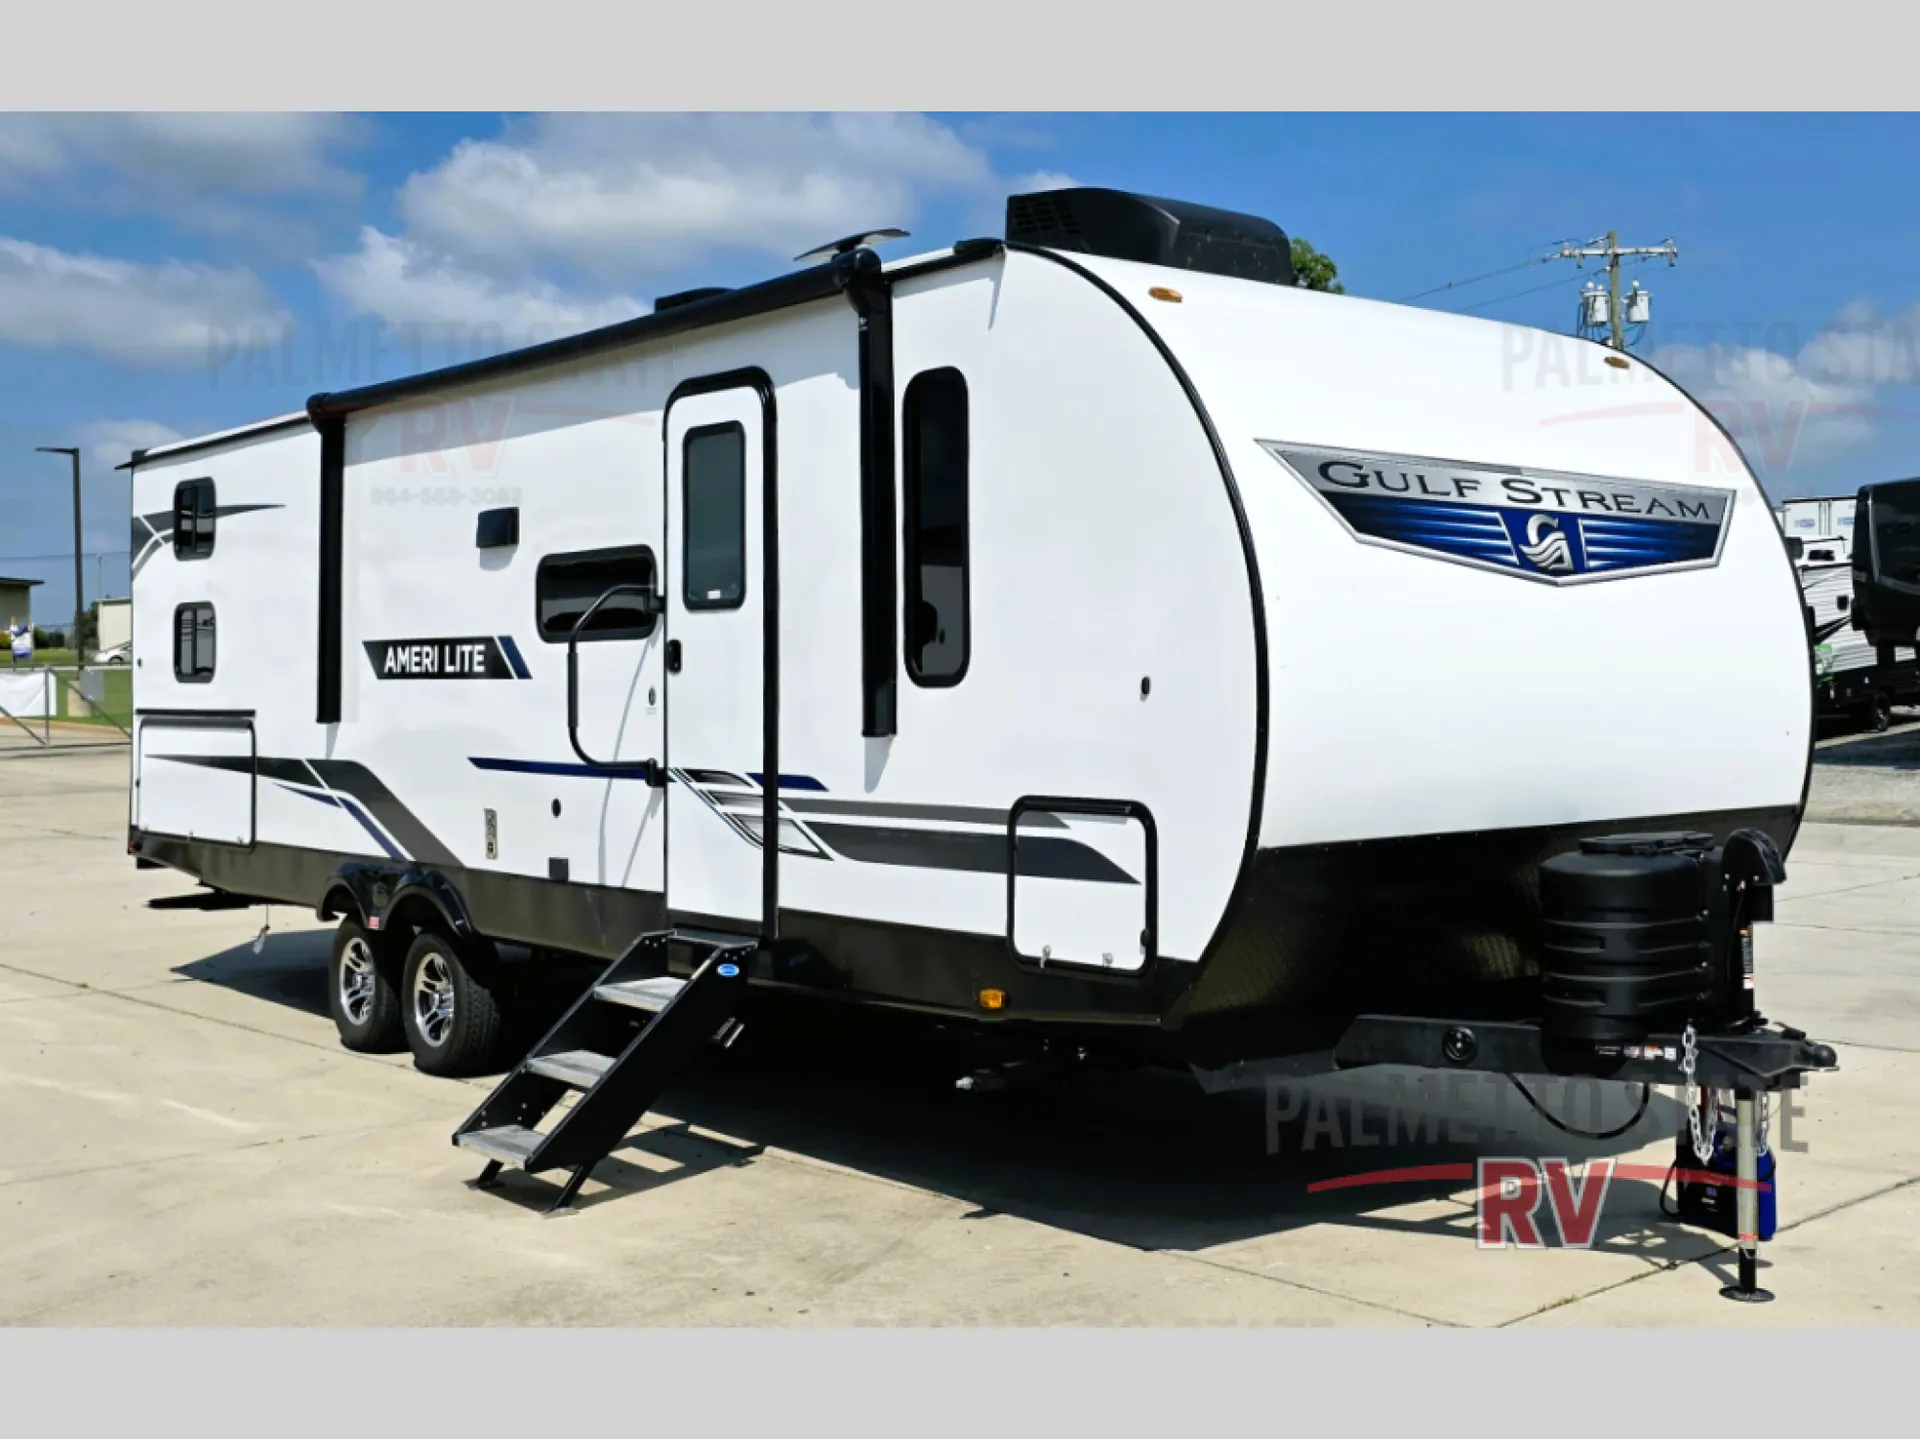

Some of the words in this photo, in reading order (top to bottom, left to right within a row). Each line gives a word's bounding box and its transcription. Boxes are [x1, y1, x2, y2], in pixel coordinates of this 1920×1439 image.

[1317, 461, 1482, 499] GULF
[1500, 477, 1711, 521] STREAM
[383, 644, 440, 674] AMERI
[443, 644, 487, 673] LITE
